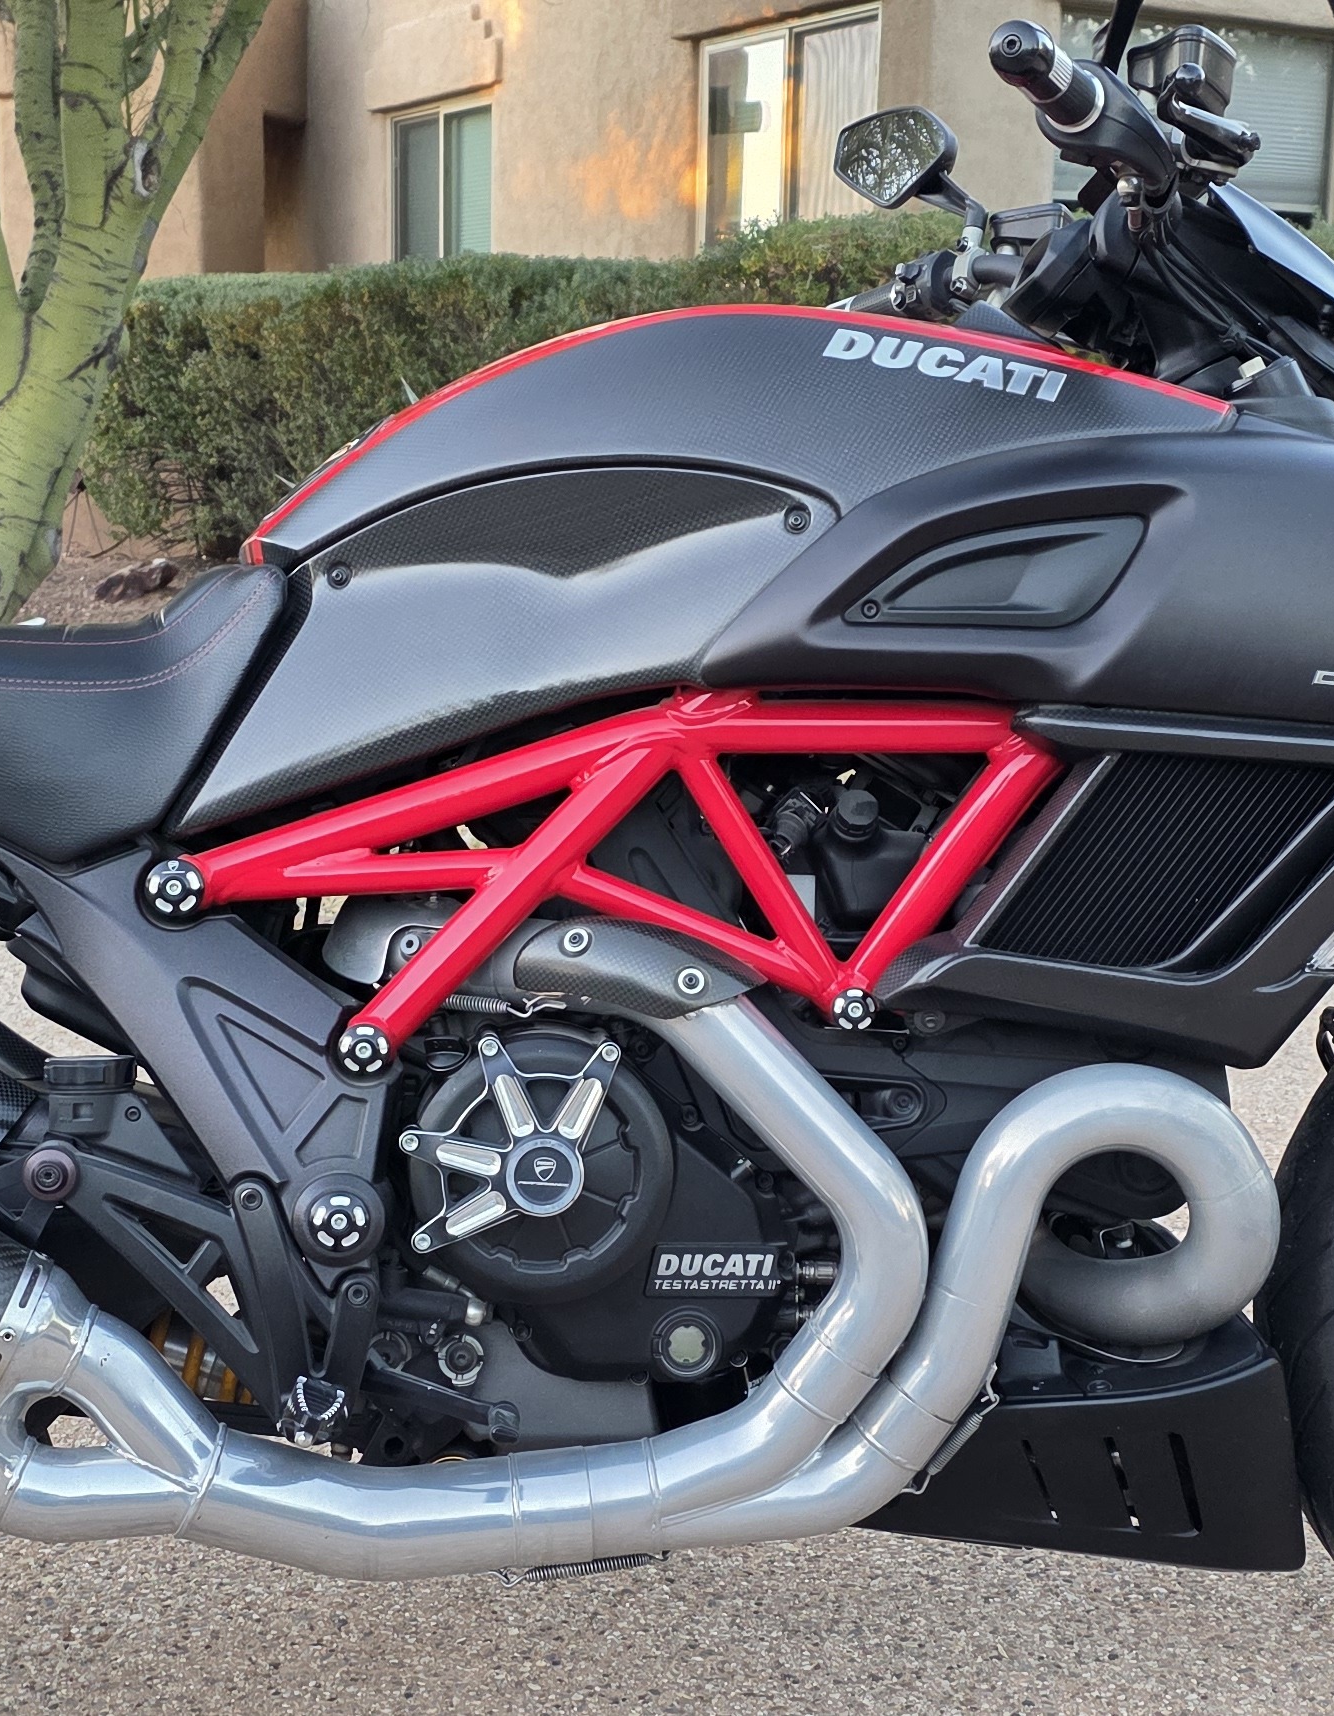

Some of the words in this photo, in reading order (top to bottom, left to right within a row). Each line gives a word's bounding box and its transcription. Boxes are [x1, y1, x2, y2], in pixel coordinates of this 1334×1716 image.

[823, 328, 1067, 402] DUCATI
[657, 1254, 774, 1276] DUCATI
[654, 1279, 765, 1290] TESTASTRETTA
